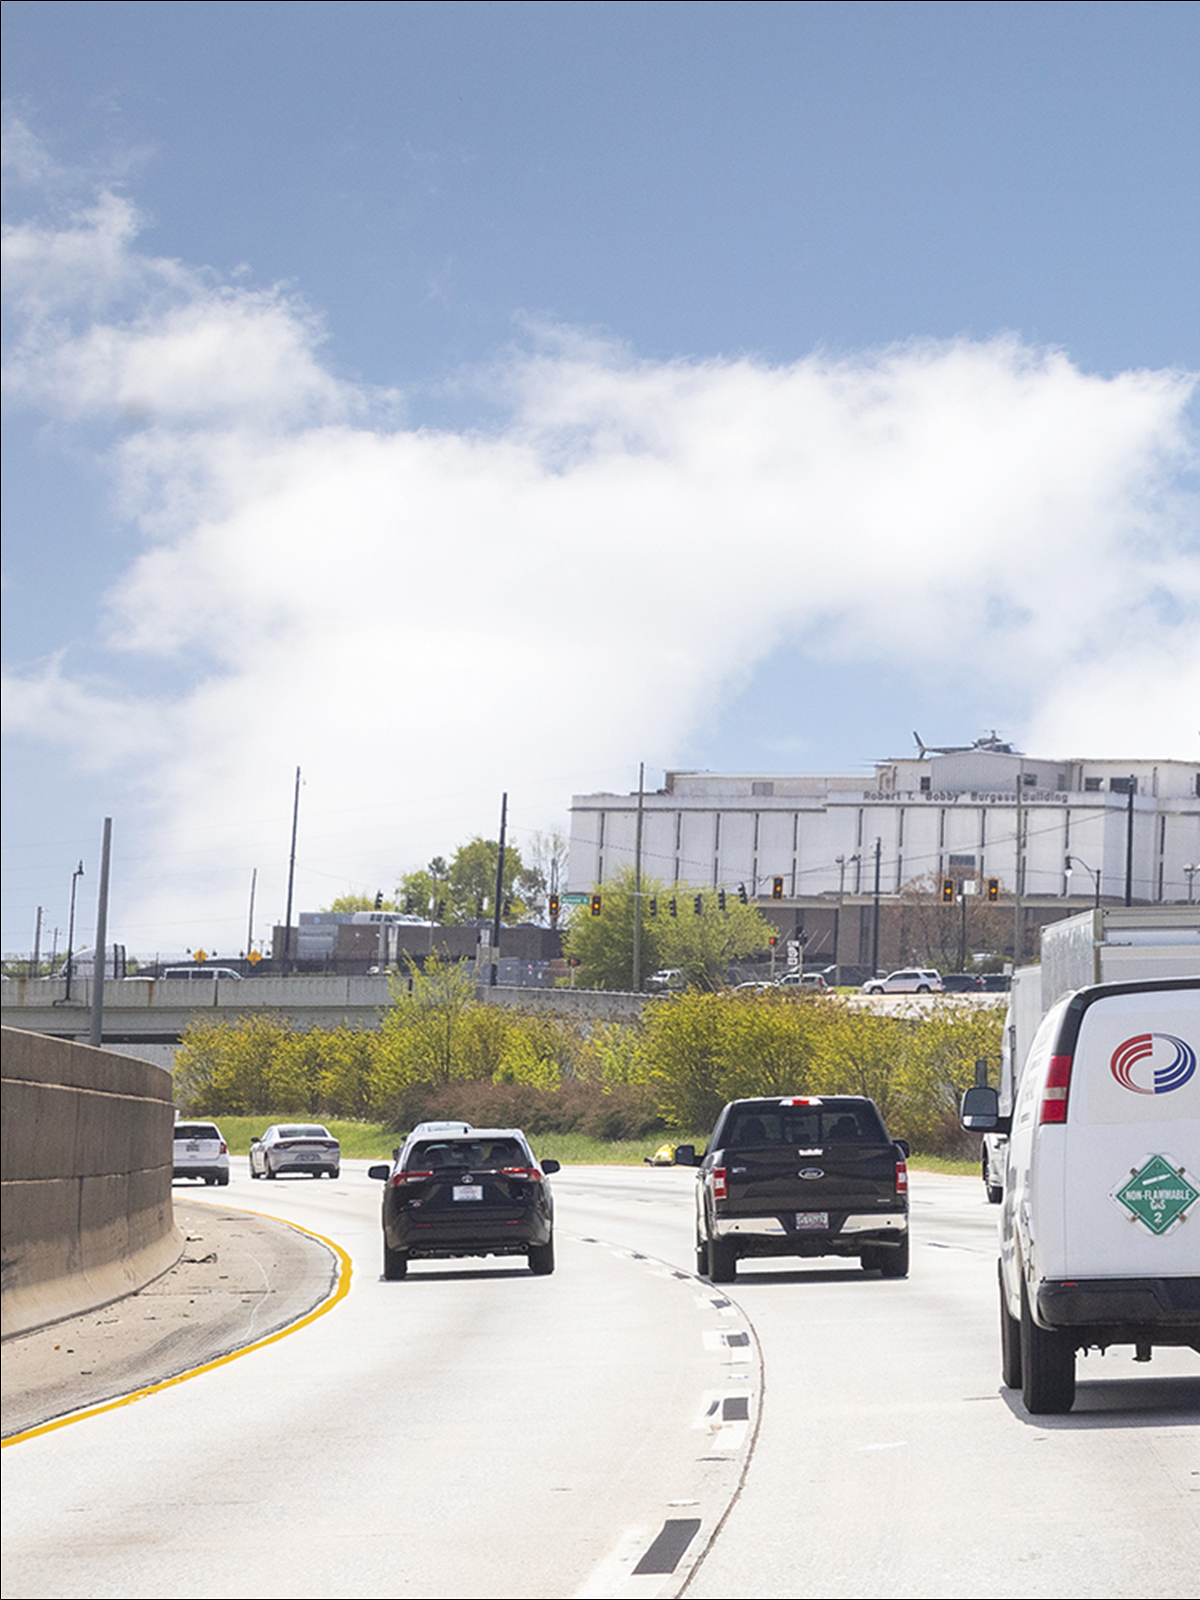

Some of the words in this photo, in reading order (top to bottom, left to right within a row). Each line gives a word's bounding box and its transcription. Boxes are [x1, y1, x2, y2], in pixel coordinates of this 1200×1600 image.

[863, 790, 900, 801] Robert
[1022, 791, 1069, 803] Building
[1126, 1189, 1190, 1200] NON-FLAMMABLE
[1154, 1211, 1162, 1224] 2
